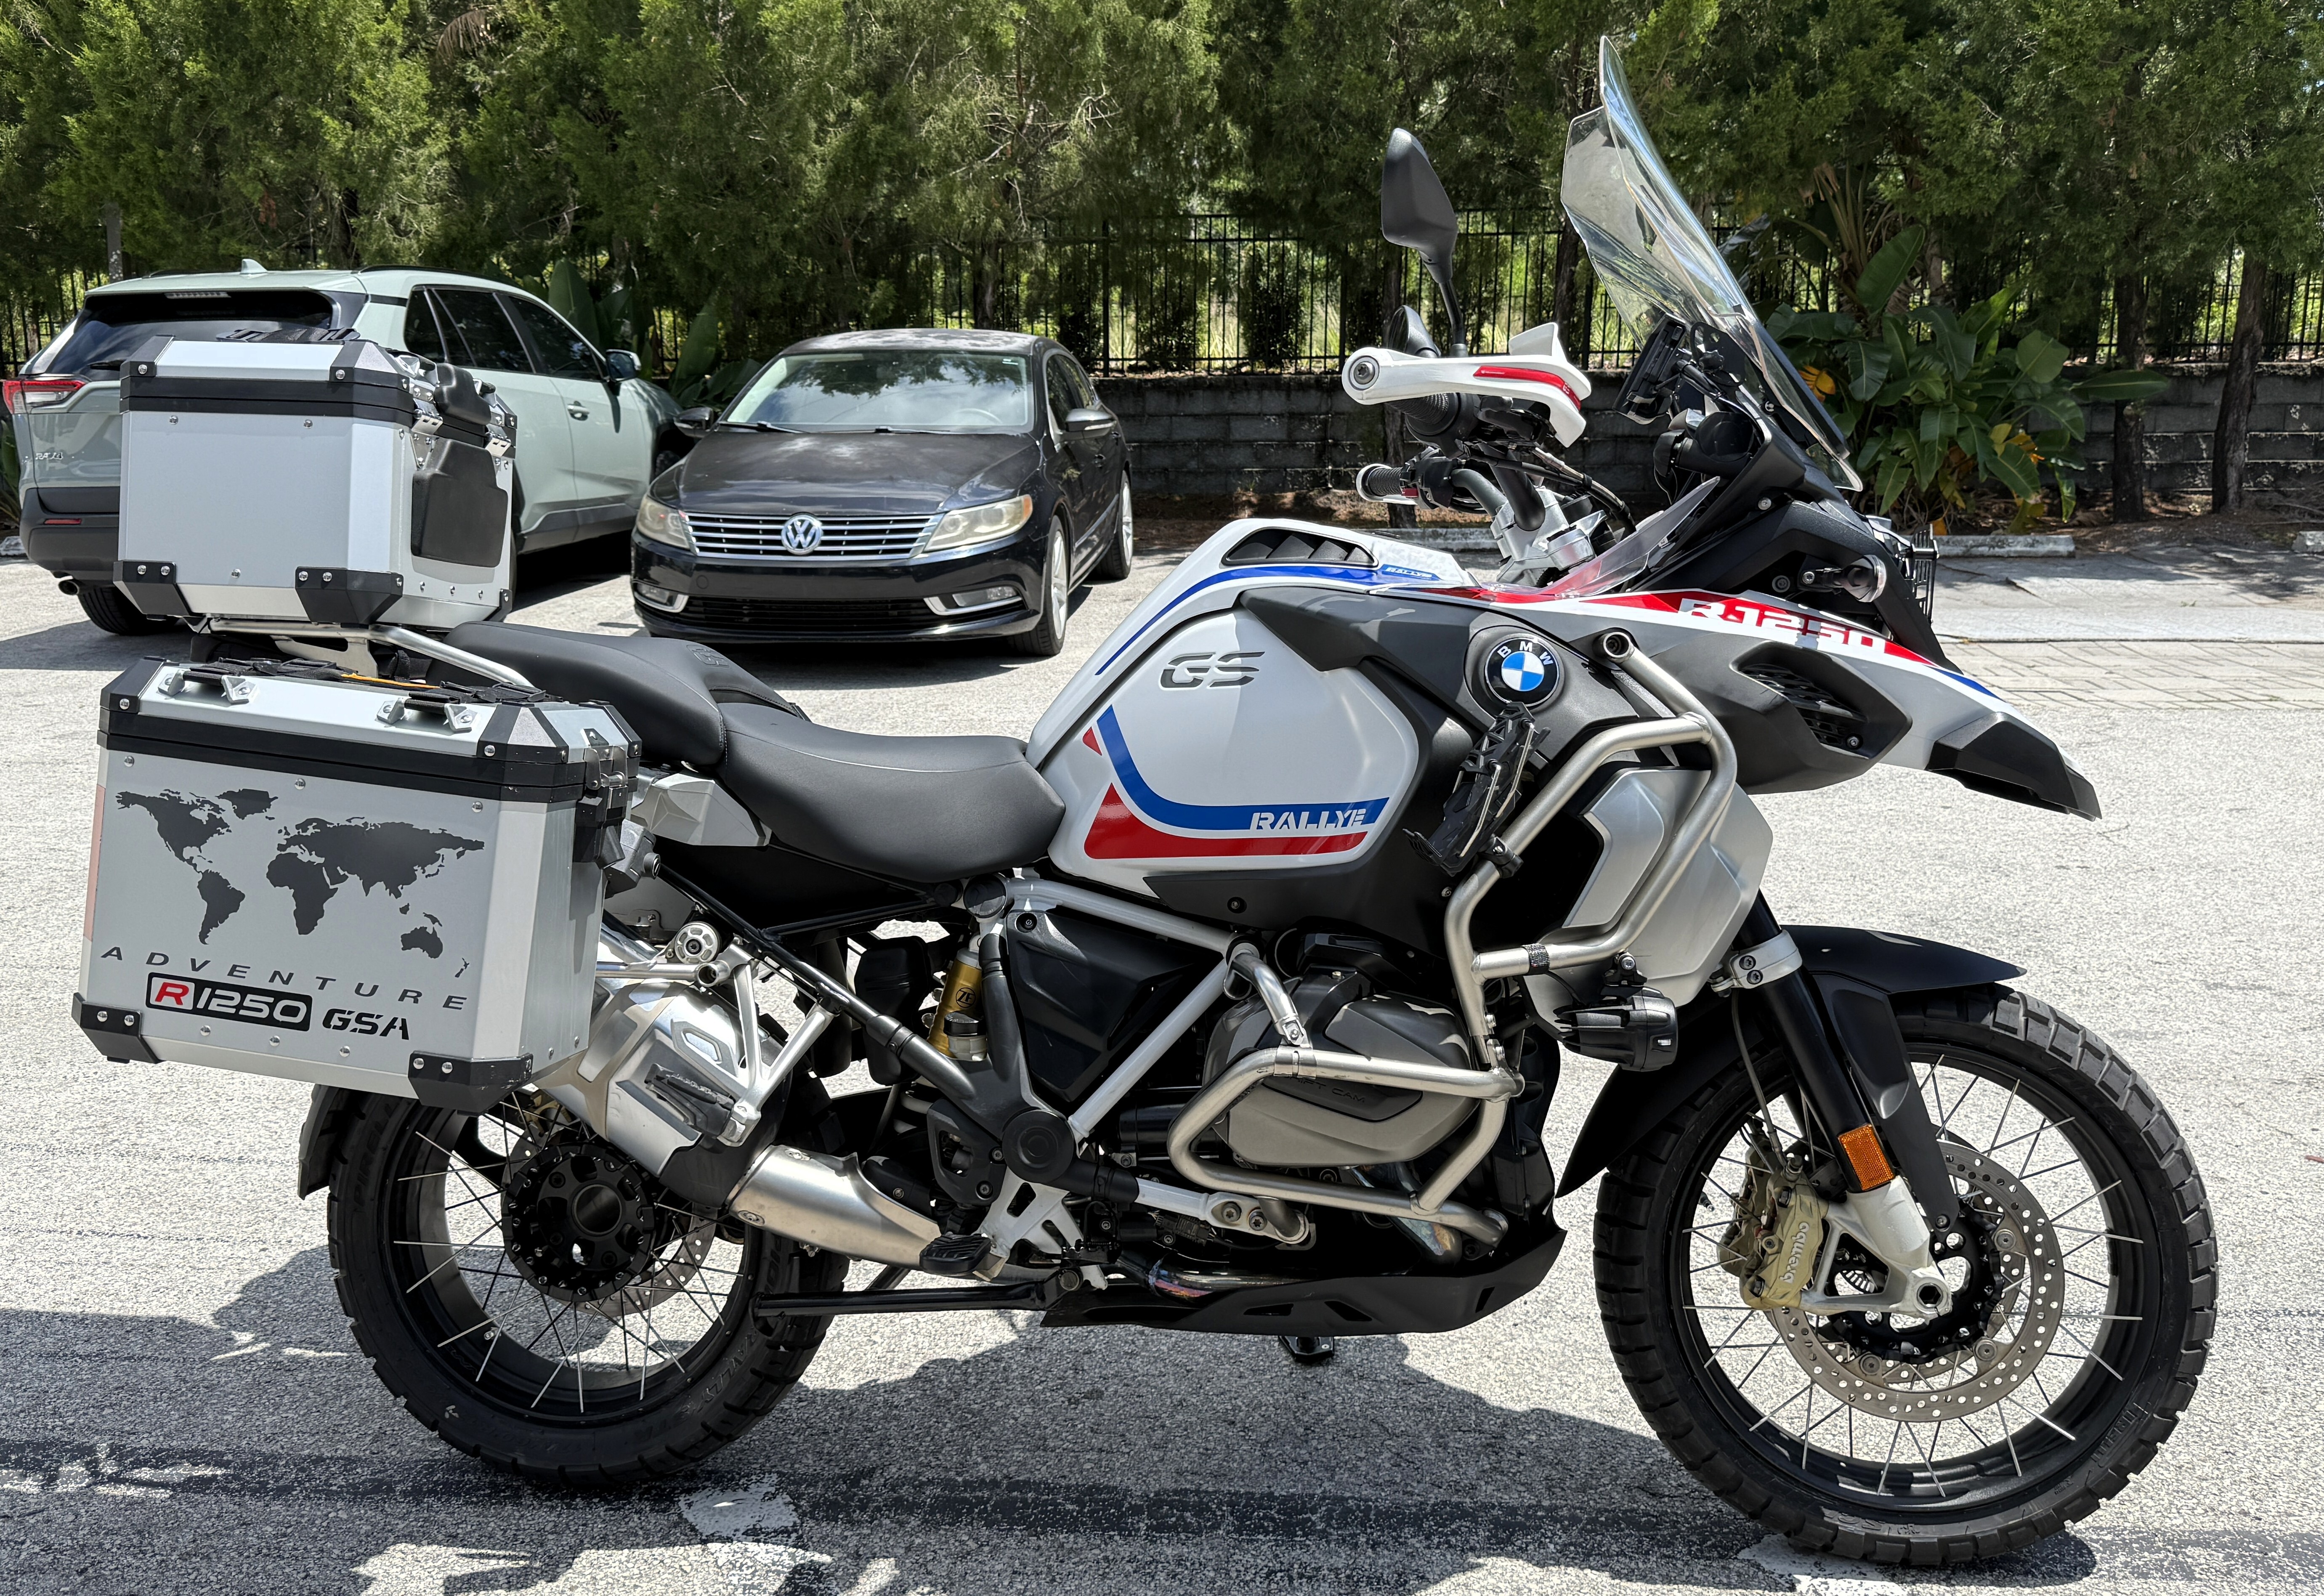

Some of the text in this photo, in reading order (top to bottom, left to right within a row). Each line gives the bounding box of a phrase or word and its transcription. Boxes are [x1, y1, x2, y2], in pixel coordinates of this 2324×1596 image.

[1496, 640, 1554, 666] BMW
[1158, 651, 1265, 690] GS
[1249, 807, 1366, 831] RALLYE
[100, 946, 467, 1011] ADVENTURE
[956, 990, 975, 1005] ZF
[322, 1007, 410, 1041] GSA
[1332, 1088, 1365, 1103] CAM
[353, 1100, 400, 1208] PIRELL
[1779, 1221, 1810, 1284] brembo
